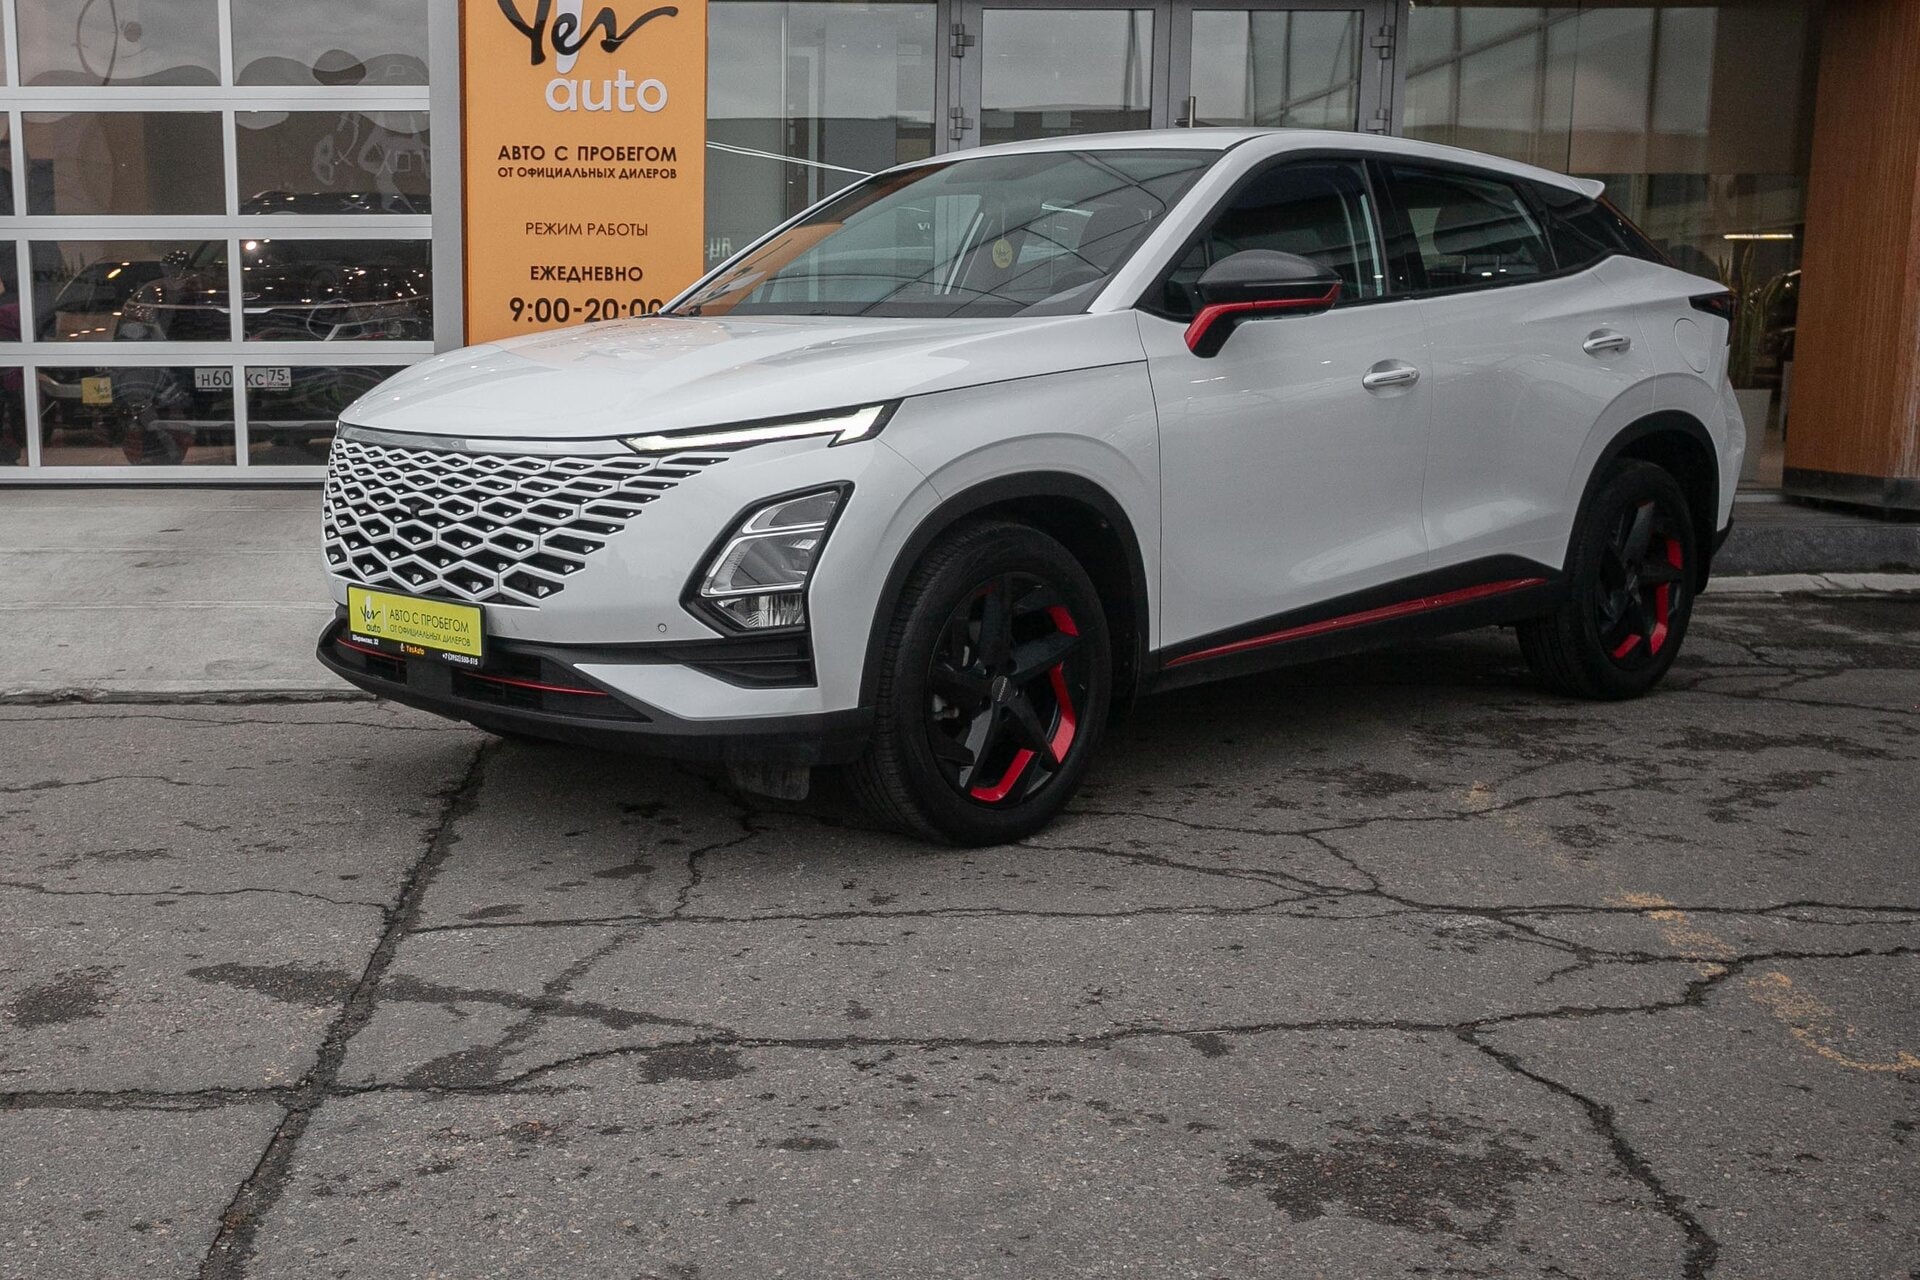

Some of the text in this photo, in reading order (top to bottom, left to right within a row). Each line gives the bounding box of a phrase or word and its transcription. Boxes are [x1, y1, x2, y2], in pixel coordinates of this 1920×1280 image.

[545, 69, 668, 113] auto
[498, 145, 677, 162] АВТО С ПРОБЕГОМ
[498, 167, 677, 179] ОТ ОФИЦИАЛЬНЫХ ДИЛЕРОВ
[525, 223, 648, 236] РЕЖИМ РАБОТЫ
[530, 266, 643, 283] ЕЖЕДНЕВНО
[269, 369, 285, 381] 75
[360, 604, 381, 622] Yes
[390, 608, 469, 633] АВТО С ПРОБЕГОМ
[366, 624, 381, 633] auto
[390, 624, 471, 647] ОТ ОФИЦИАЛЬНЫХ ДИЛЕРОВ
